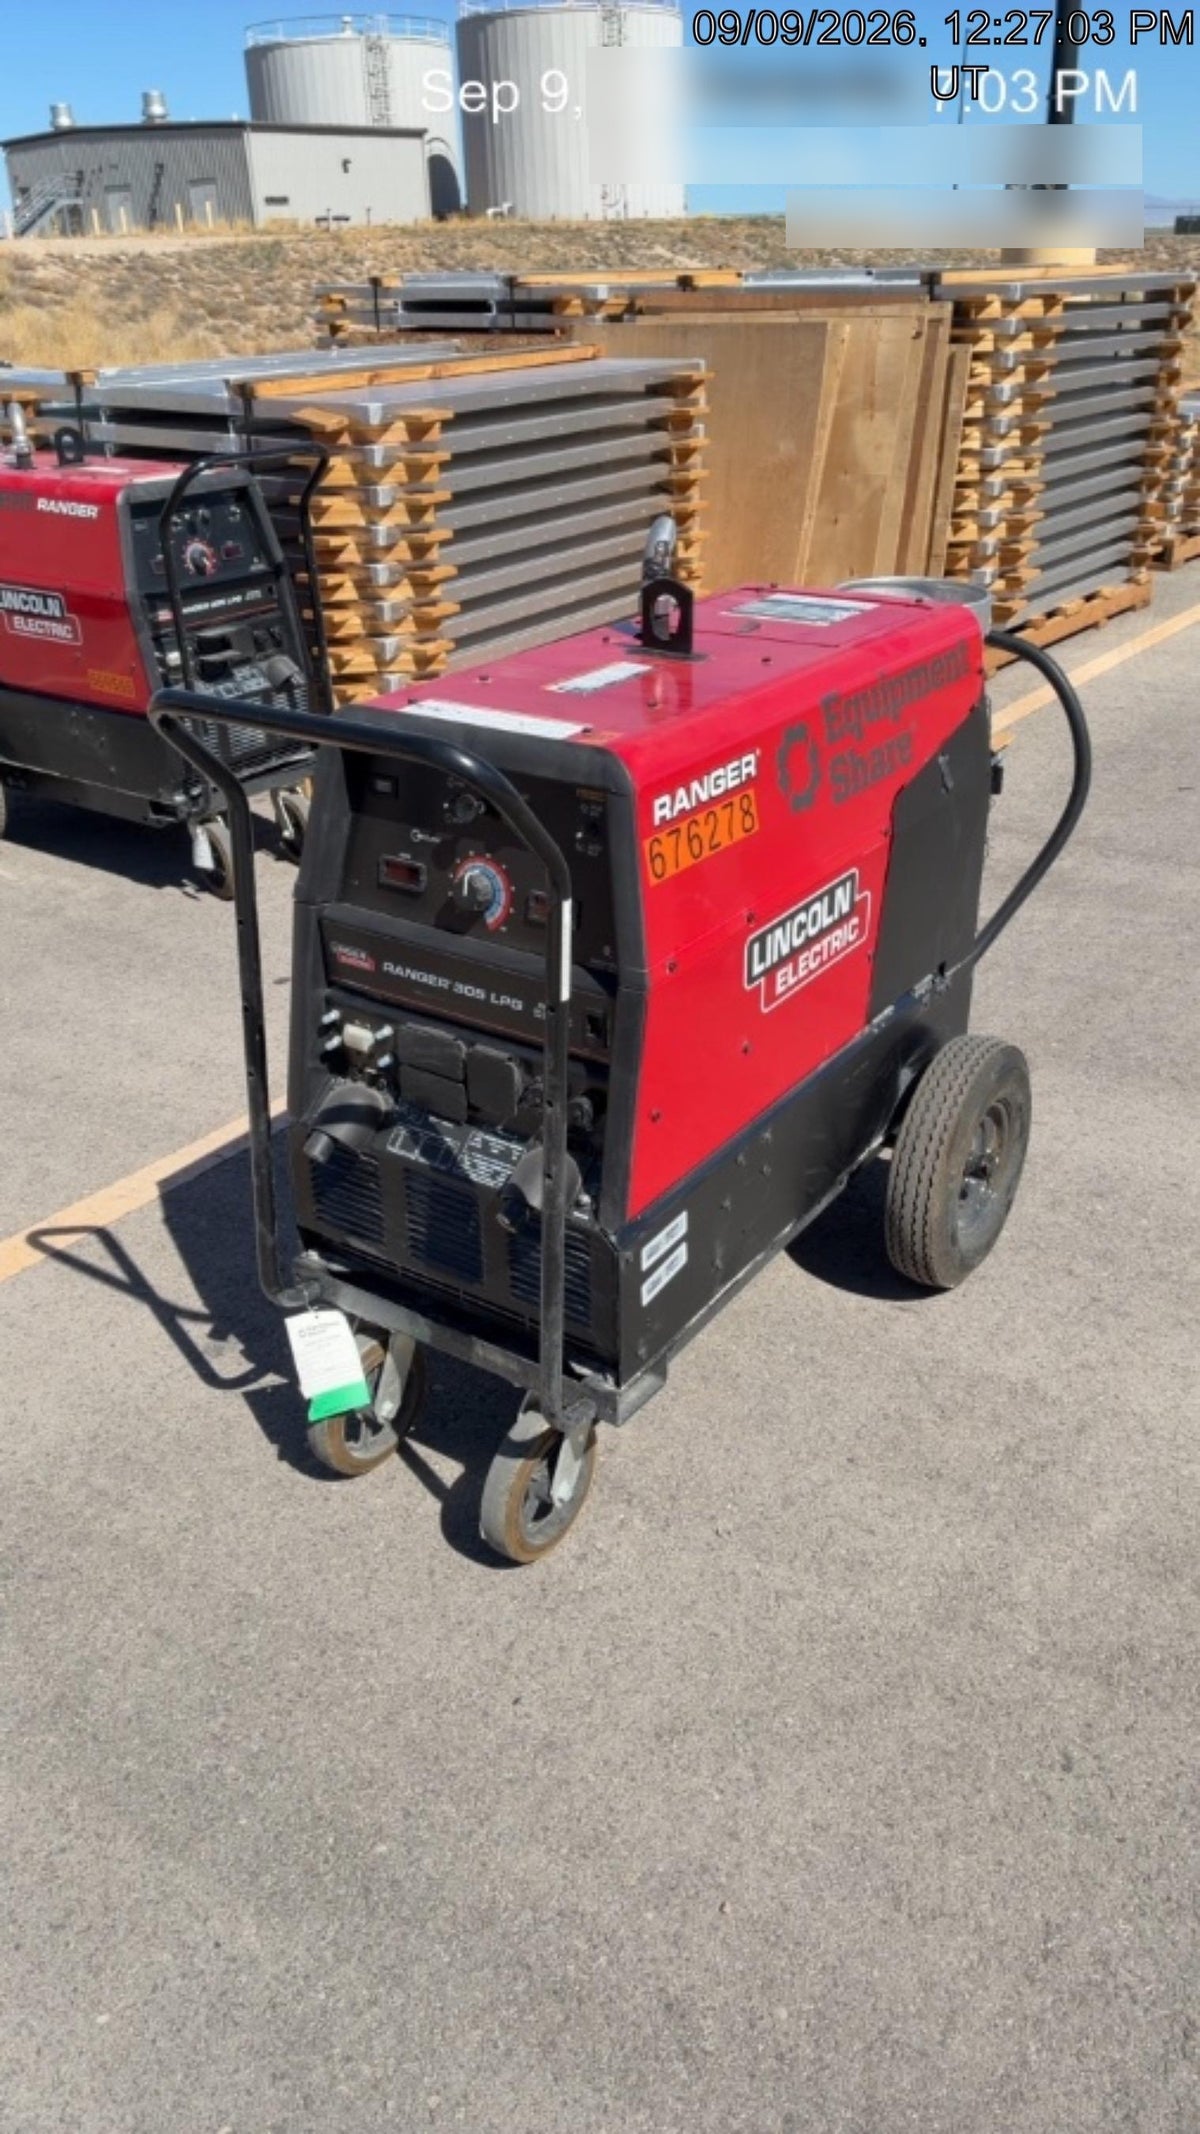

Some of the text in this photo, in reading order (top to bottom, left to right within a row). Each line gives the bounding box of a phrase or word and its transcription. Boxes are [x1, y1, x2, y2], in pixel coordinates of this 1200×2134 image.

[37, 497, 98, 519] RANGER
[13, 616, 73, 639] ELECTRIC
[820, 638, 970, 745] Equipment
[653, 752, 757, 826] RANGER
[829, 729, 912, 805] Share
[649, 793, 755, 879] 676278
[751, 879, 852, 978] LINCOLN
[774, 916, 859, 996] ELECTRIC
[383, 961, 450, 990] RANGER
[453, 981, 486, 1001] 305
[490, 991, 524, 1012] LPG
